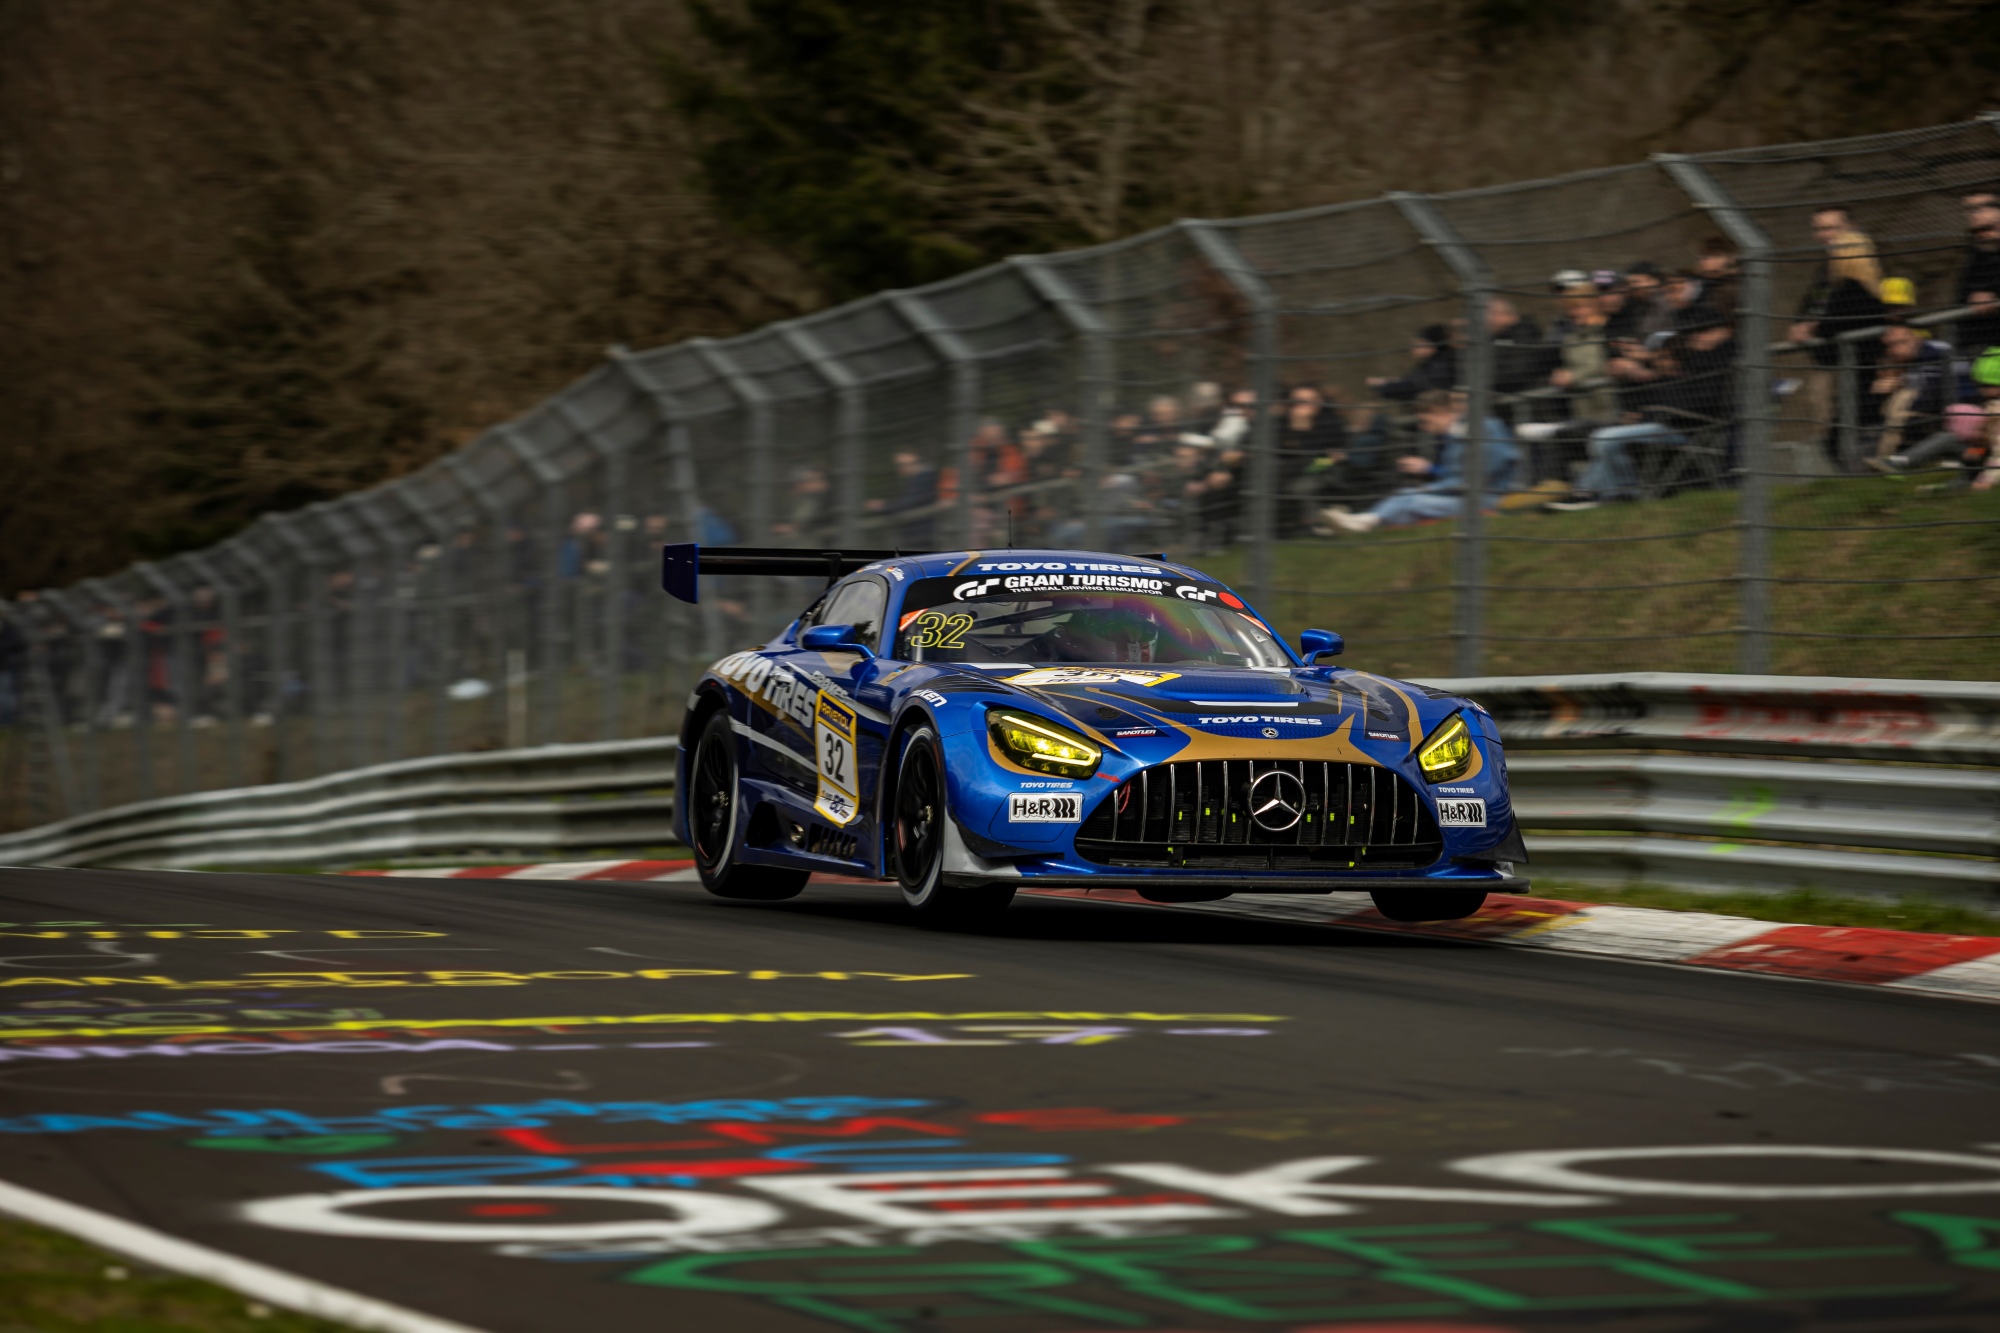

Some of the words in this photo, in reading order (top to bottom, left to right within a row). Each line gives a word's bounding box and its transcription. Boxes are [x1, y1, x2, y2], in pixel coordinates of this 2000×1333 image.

[978, 562, 1067, 571] TOYO
[1070, 563, 1162, 574] TIRES
[1004, 575, 1064, 589] GRAN
[1104, 586, 1163, 596] SIMULATOR
[910, 612, 974, 649] 32
[712, 651, 774, 692] TOYO
[761, 666, 818, 728] TIRES
[1198, 716, 1259, 724] TOYO
[1261, 716, 1322, 725] TIRES
[824, 733, 845, 783] 32
[1013, 798, 1053, 818] H&R
[1439, 802, 1467, 821] H&R
[243, 969, 975, 982] TROPHY
